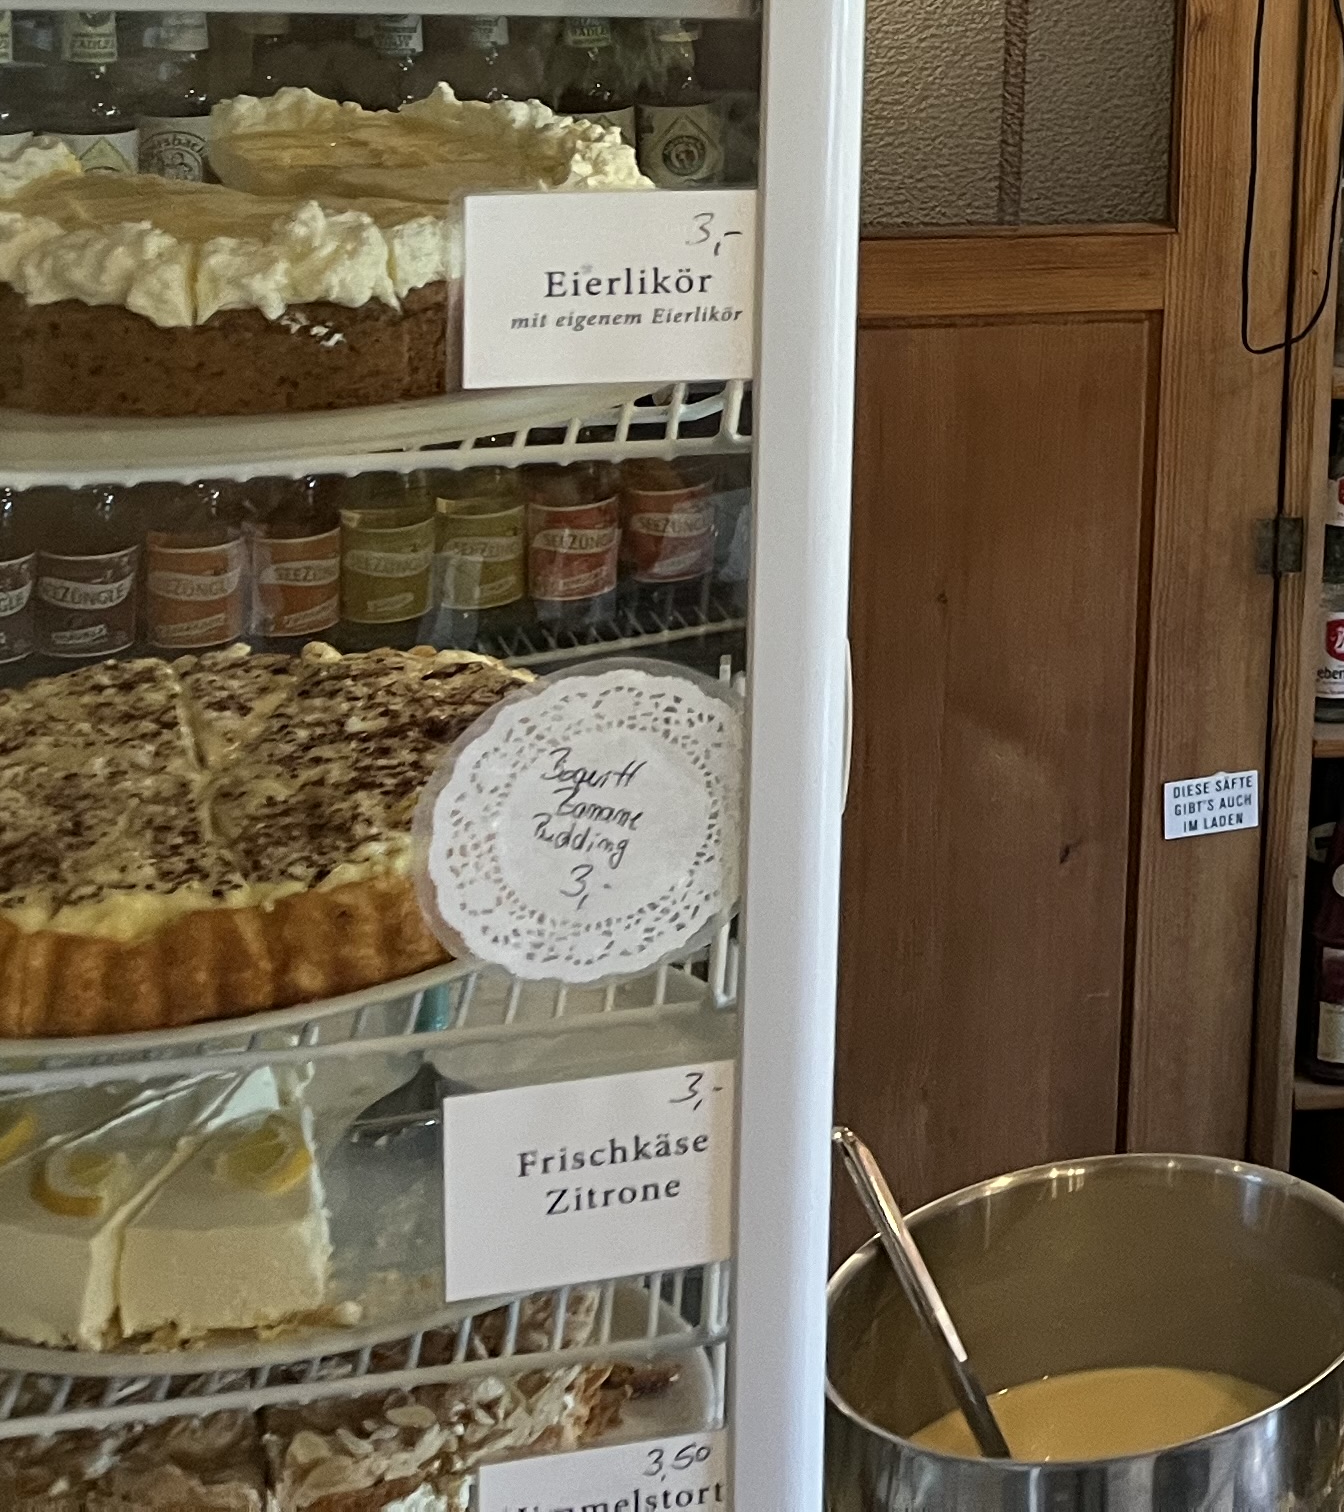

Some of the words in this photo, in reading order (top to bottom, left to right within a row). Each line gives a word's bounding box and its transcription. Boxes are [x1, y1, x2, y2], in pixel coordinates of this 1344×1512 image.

[543, 267, 713, 298] Eierlikör
[510, 313, 548, 330] mit
[555, 310, 642, 332] eigenem
[651, 305, 744, 325] Eierlikör
[1173, 781, 1211, 799] DIESE
[1215, 775, 1253, 793] SÄFTE
[1219, 793, 1252, 810] AUCH
[1183, 819, 1198, 833] IM
[1203, 812, 1244, 830] LADEN
[532, 811, 631, 870] Pudding
[517, 1133, 710, 1178] Frischkäse
[545, 1178, 681, 1216] Zitrone
[642, 1441, 712, 1483] 3,50
